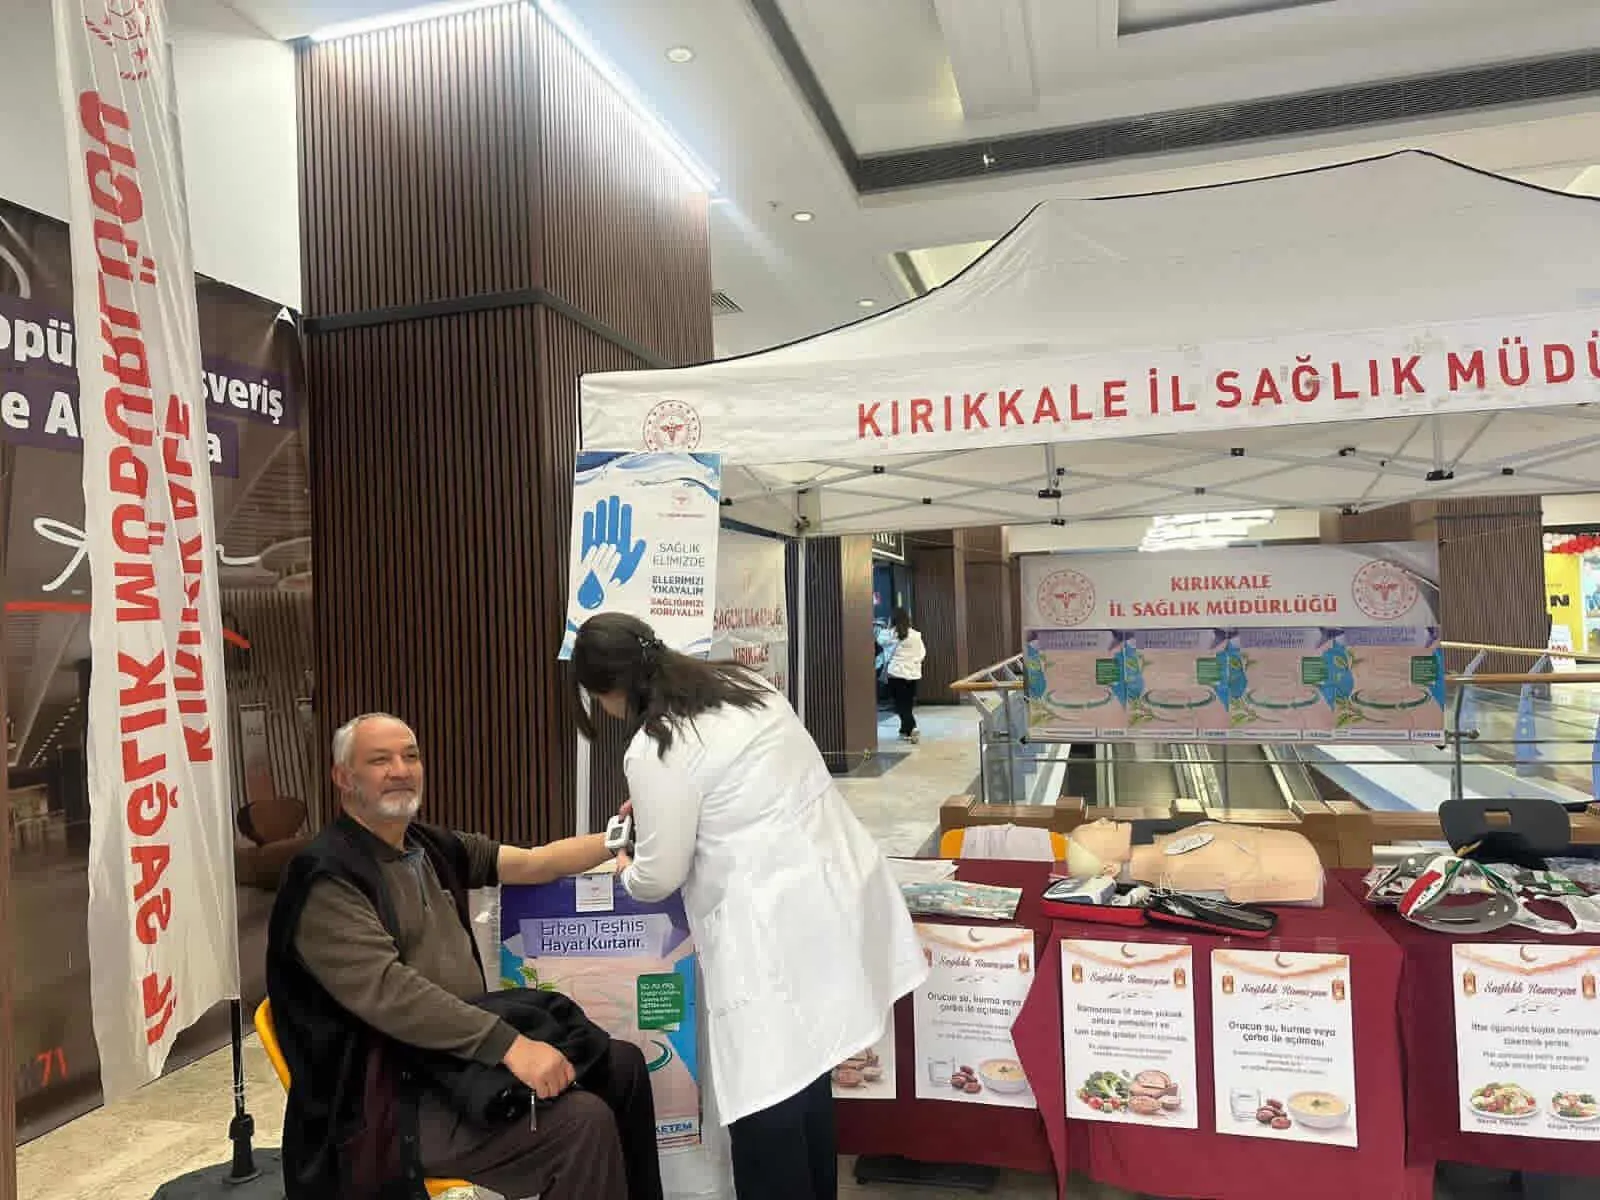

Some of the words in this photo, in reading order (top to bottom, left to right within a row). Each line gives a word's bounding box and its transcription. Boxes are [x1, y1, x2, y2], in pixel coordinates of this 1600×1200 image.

[857, 379, 1129, 438] KIRIKKALE
[1149, 367, 1197, 416] İL
[1215, 355, 1424, 411] SAĞLIK
[659, 541, 701, 553] SAĞLIK
[651, 585, 704, 595] YIKAYALIM
[1170, 574, 1273, 592] KIRIKKALE
[1108, 600, 1126, 617] İL
[1131, 599, 1201, 617] SAĞLIK
[1204, 595, 1338, 616] MÜDÜRLÜĞÜ
[541, 921, 588, 936] Erken
[592, 918, 645, 937] Teşhis
[541, 937, 584, 955] Hayat
[1228, 1020, 1262, 1032] Orucun
